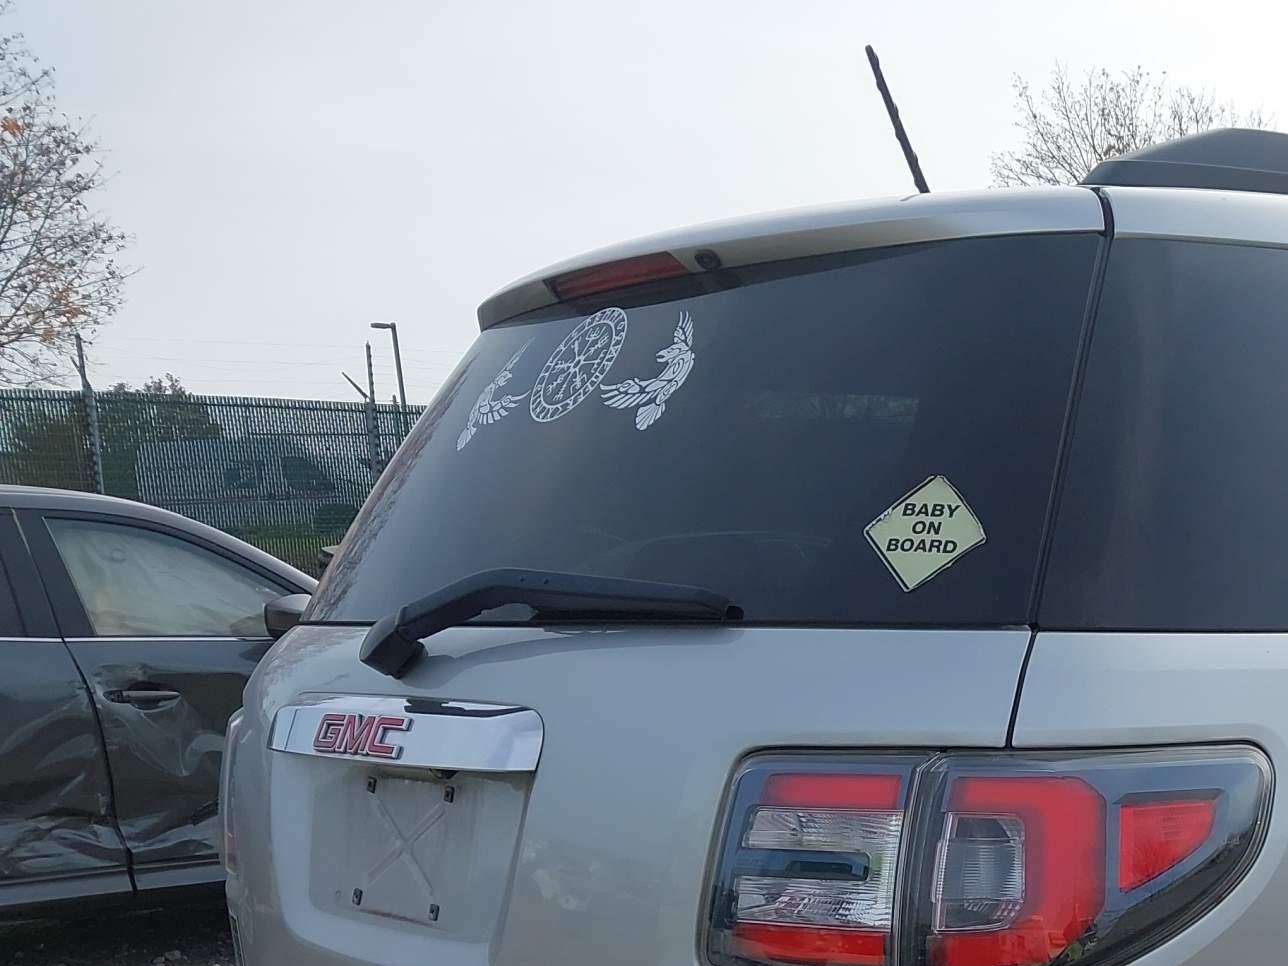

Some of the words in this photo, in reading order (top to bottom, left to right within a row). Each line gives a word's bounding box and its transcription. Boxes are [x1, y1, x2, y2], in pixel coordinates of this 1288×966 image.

[902, 503, 961, 518] BABY
[912, 521, 942, 535] ON
[886, 538, 958, 553] BOARD
[313, 713, 413, 760] GMC
